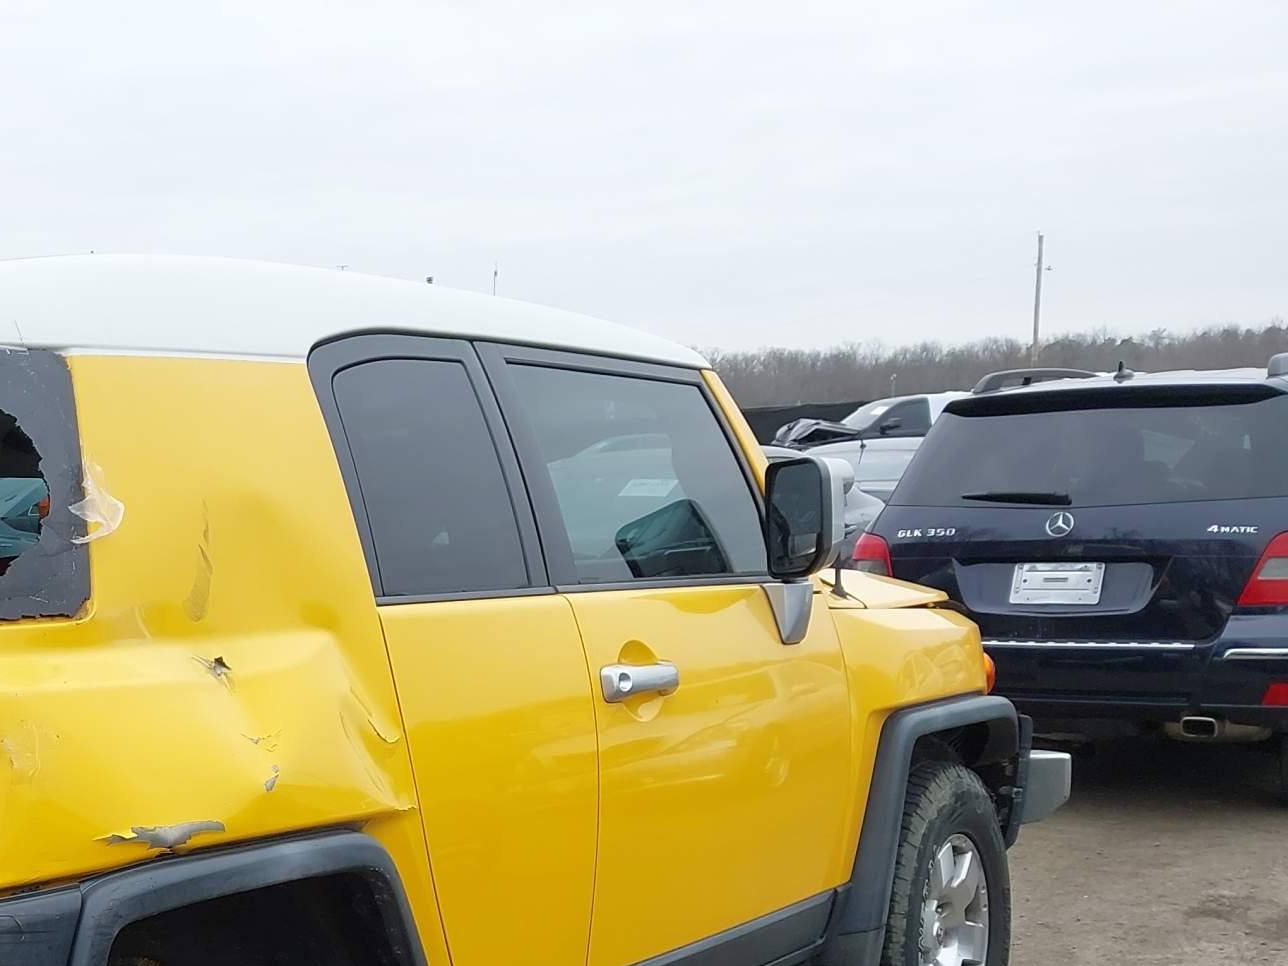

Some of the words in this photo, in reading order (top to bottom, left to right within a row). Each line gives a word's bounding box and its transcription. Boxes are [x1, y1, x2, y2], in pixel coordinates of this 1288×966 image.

[897, 529, 923, 538] GLK
[925, 527, 956, 537] 350
[1206, 524, 1259, 534] 4MATIC
